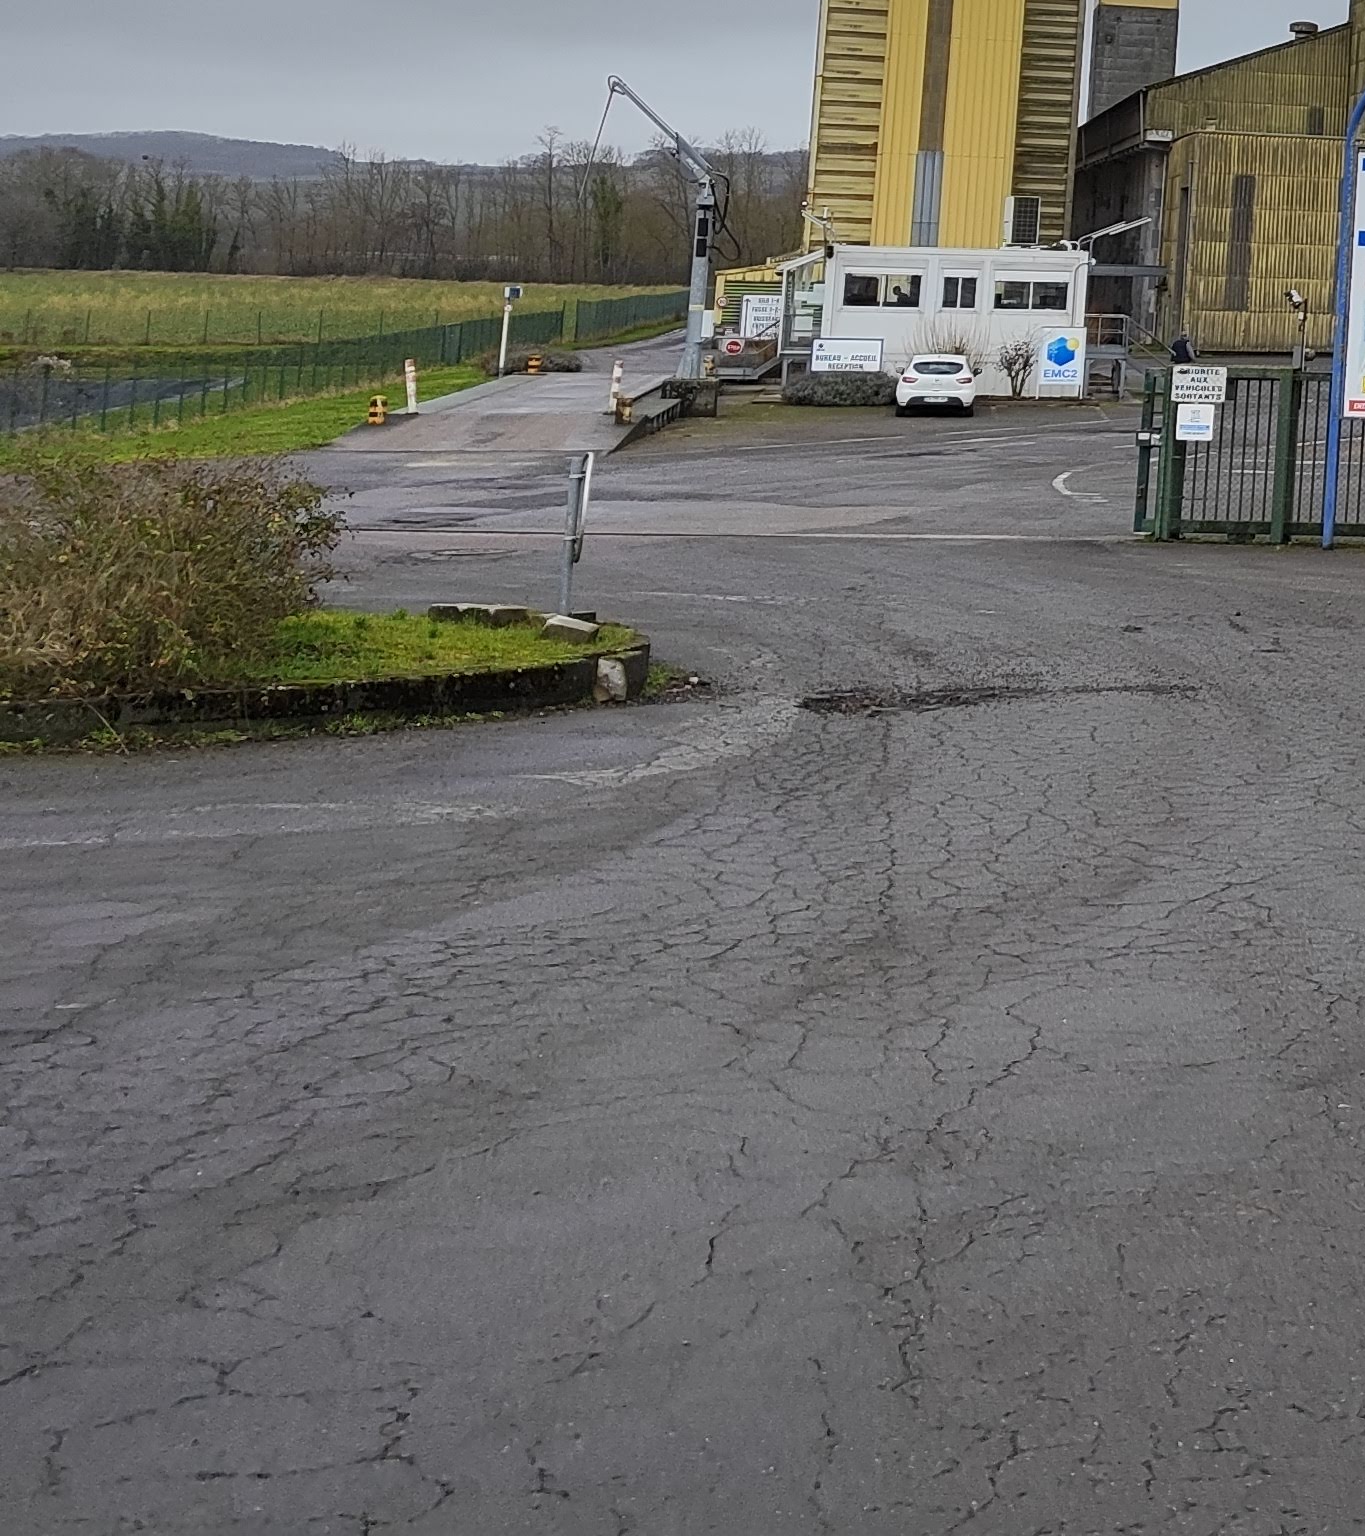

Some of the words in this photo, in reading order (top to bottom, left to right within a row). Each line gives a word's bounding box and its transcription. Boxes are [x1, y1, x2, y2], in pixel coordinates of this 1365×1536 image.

[815, 354, 842, 362] BUREAU
[1043, 369, 1078, 378] EMC2
[1174, 384, 1223, 392] VEHICULES
